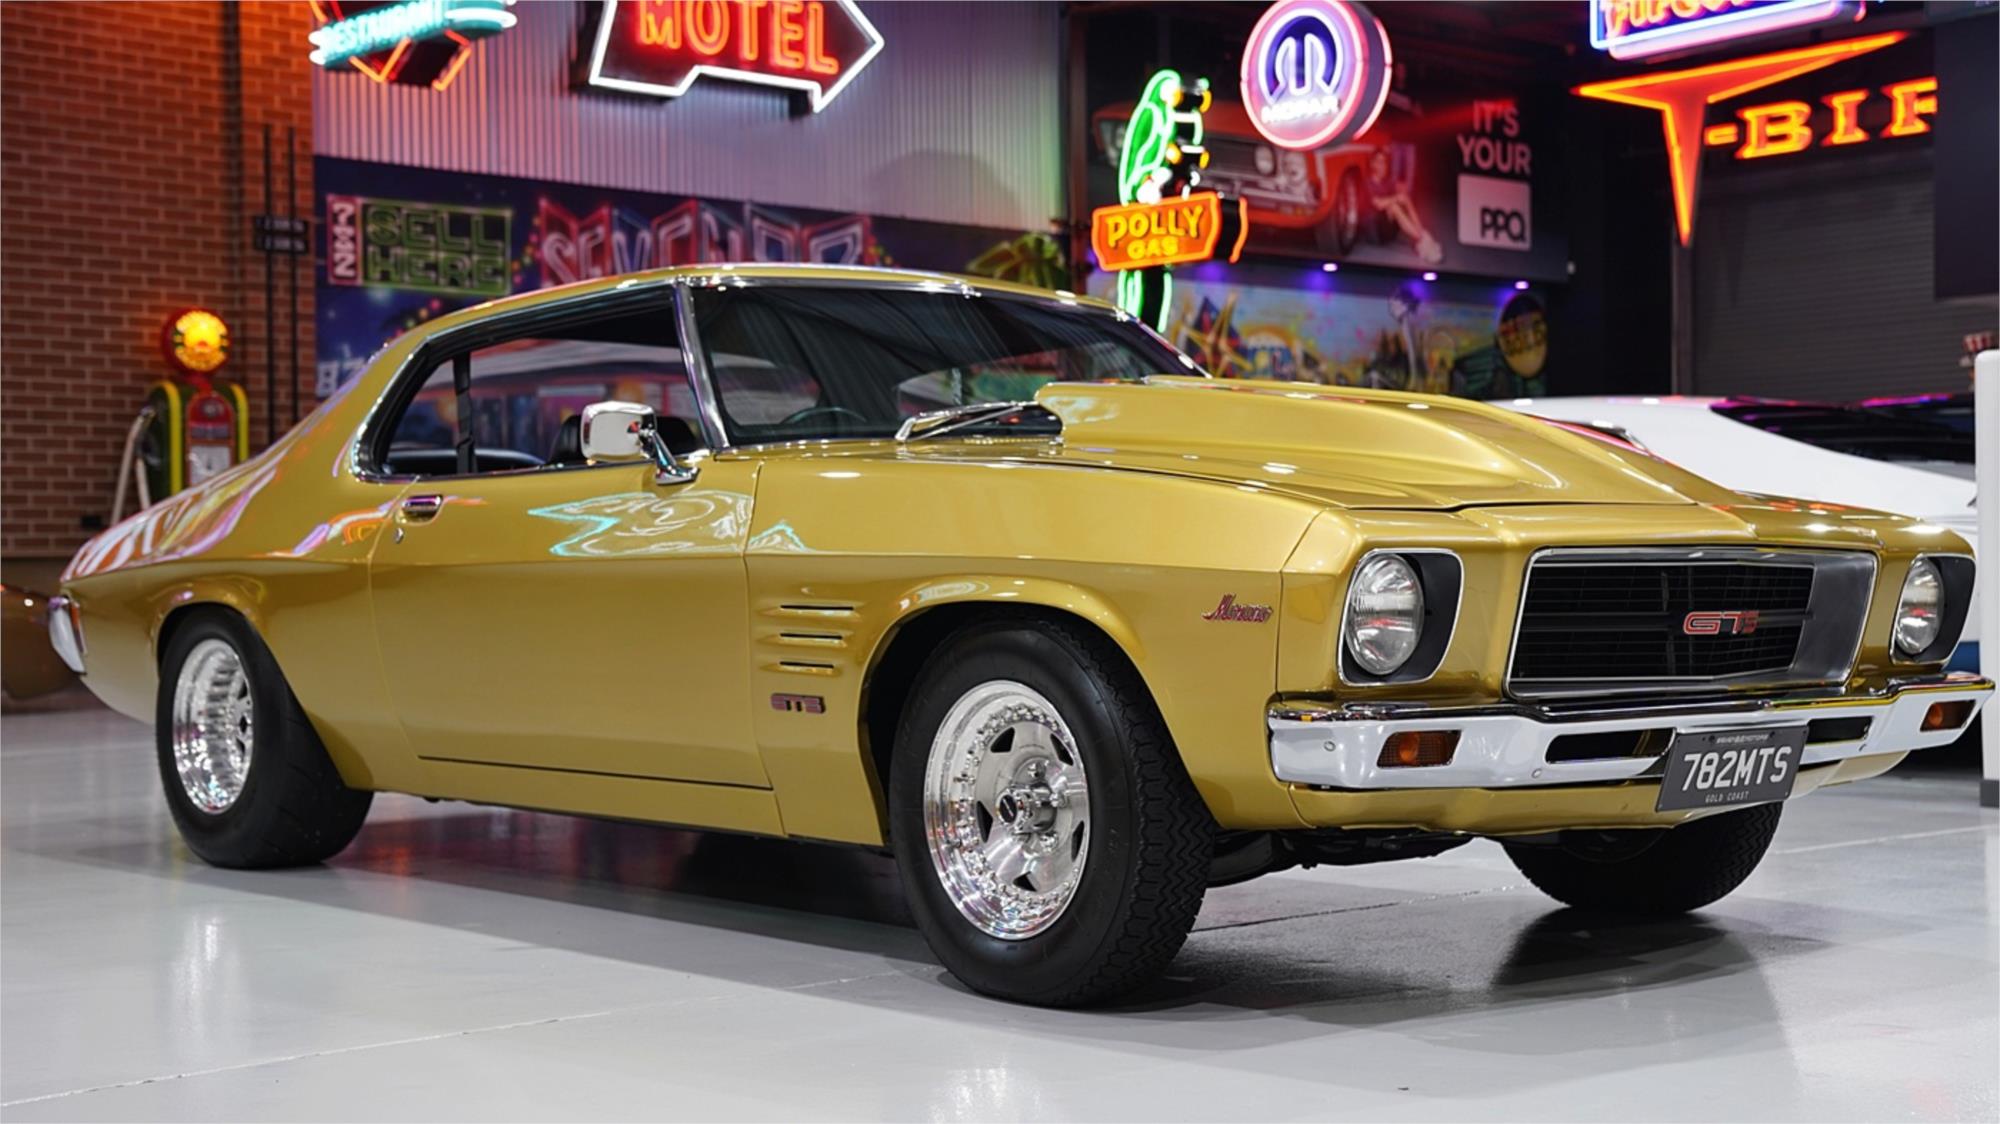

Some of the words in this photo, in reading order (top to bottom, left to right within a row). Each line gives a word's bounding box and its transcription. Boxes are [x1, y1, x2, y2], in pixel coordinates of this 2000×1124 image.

[637, 0, 839, 75] MOTEL
[1473, 101, 1520, 137] IT'S
[1457, 134, 1532, 175] YOUR
[367, 206, 503, 248] SELL
[1106, 205, 1203, 248] POLLY
[1481, 207, 1527, 243] PPQ
[368, 246, 504, 288] HERE
[1127, 236, 1178, 260] GAS
[1683, 611, 1760, 635] GTS
[1682, 747, 1793, 792] 782MTS
[1705, 793, 1724, 804] GOLD
[1727, 791, 1750, 802] COAST
